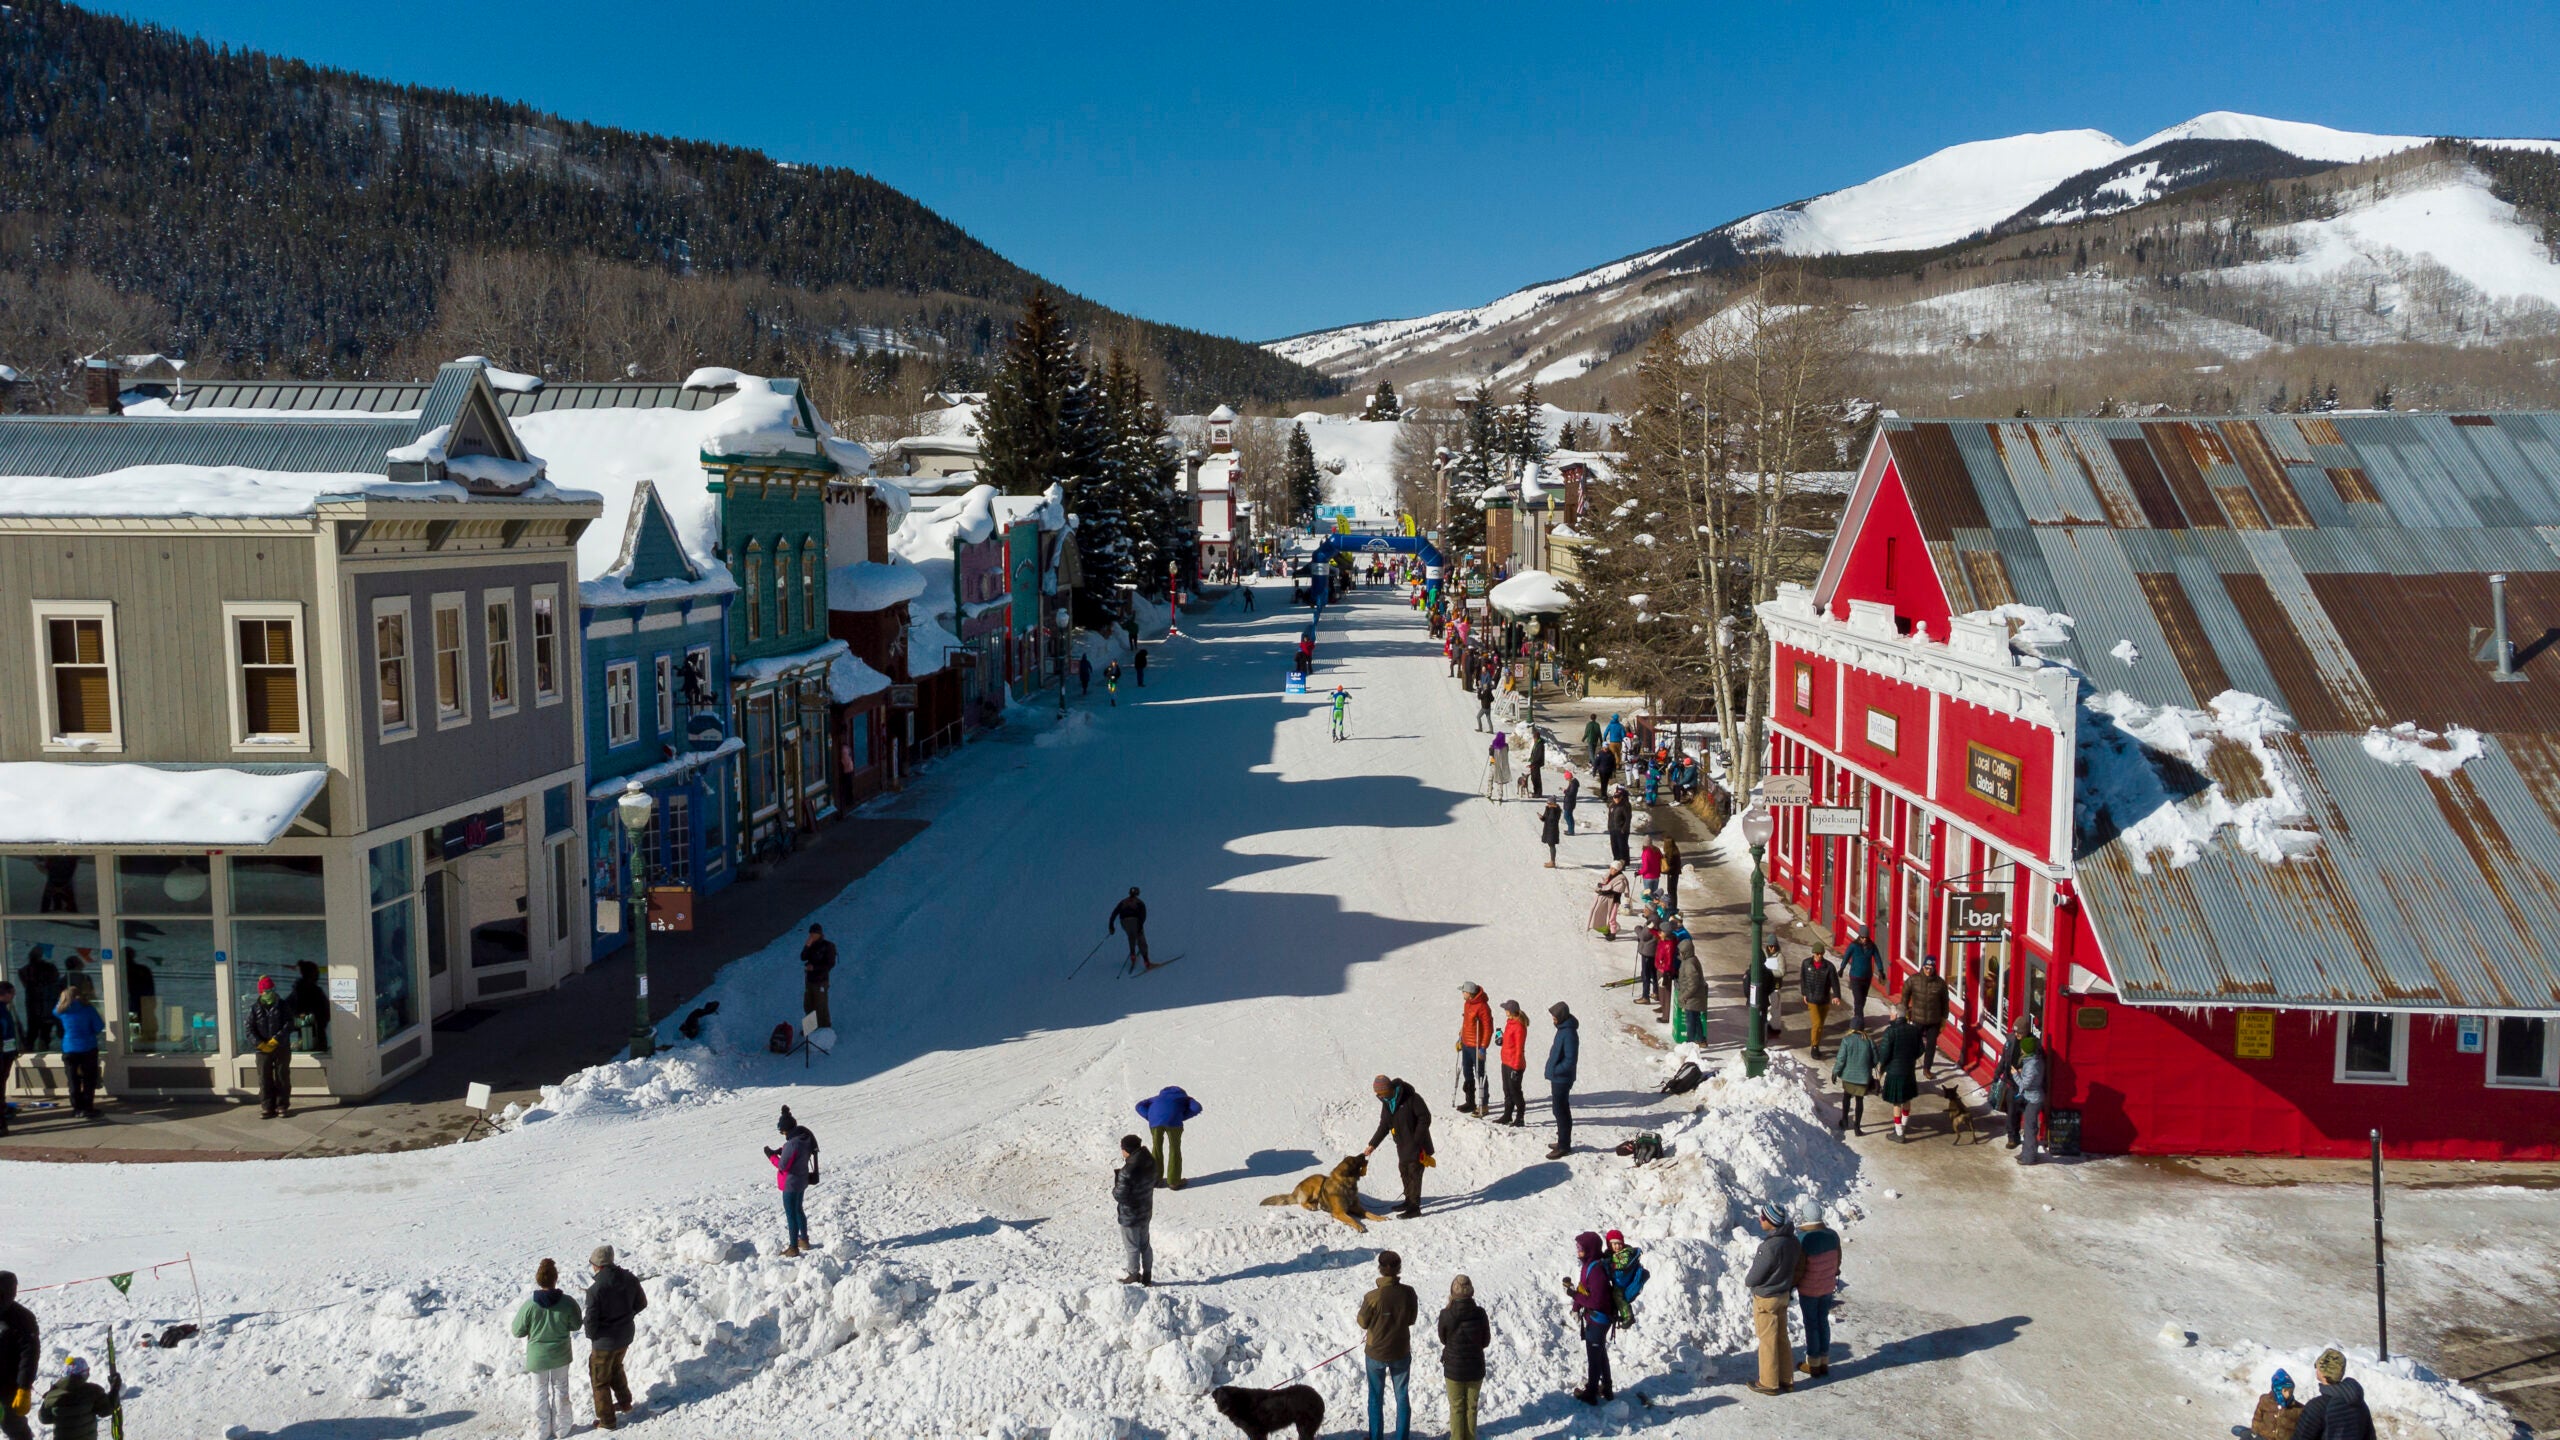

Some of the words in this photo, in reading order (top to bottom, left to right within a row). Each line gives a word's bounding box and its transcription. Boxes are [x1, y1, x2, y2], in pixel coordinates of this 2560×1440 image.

[1542, 672, 1551, 680] 15
[1974, 751, 1990, 772] Local
[1991, 759, 2012, 781] Coffee
[1976, 773, 1995, 795] Global
[1996, 782, 2008, 801] Tea
[1764, 796, 1809, 804] ANGLER
[1812, 813, 1858, 825] björkstam
[1951, 896, 2002, 927] T-bar
